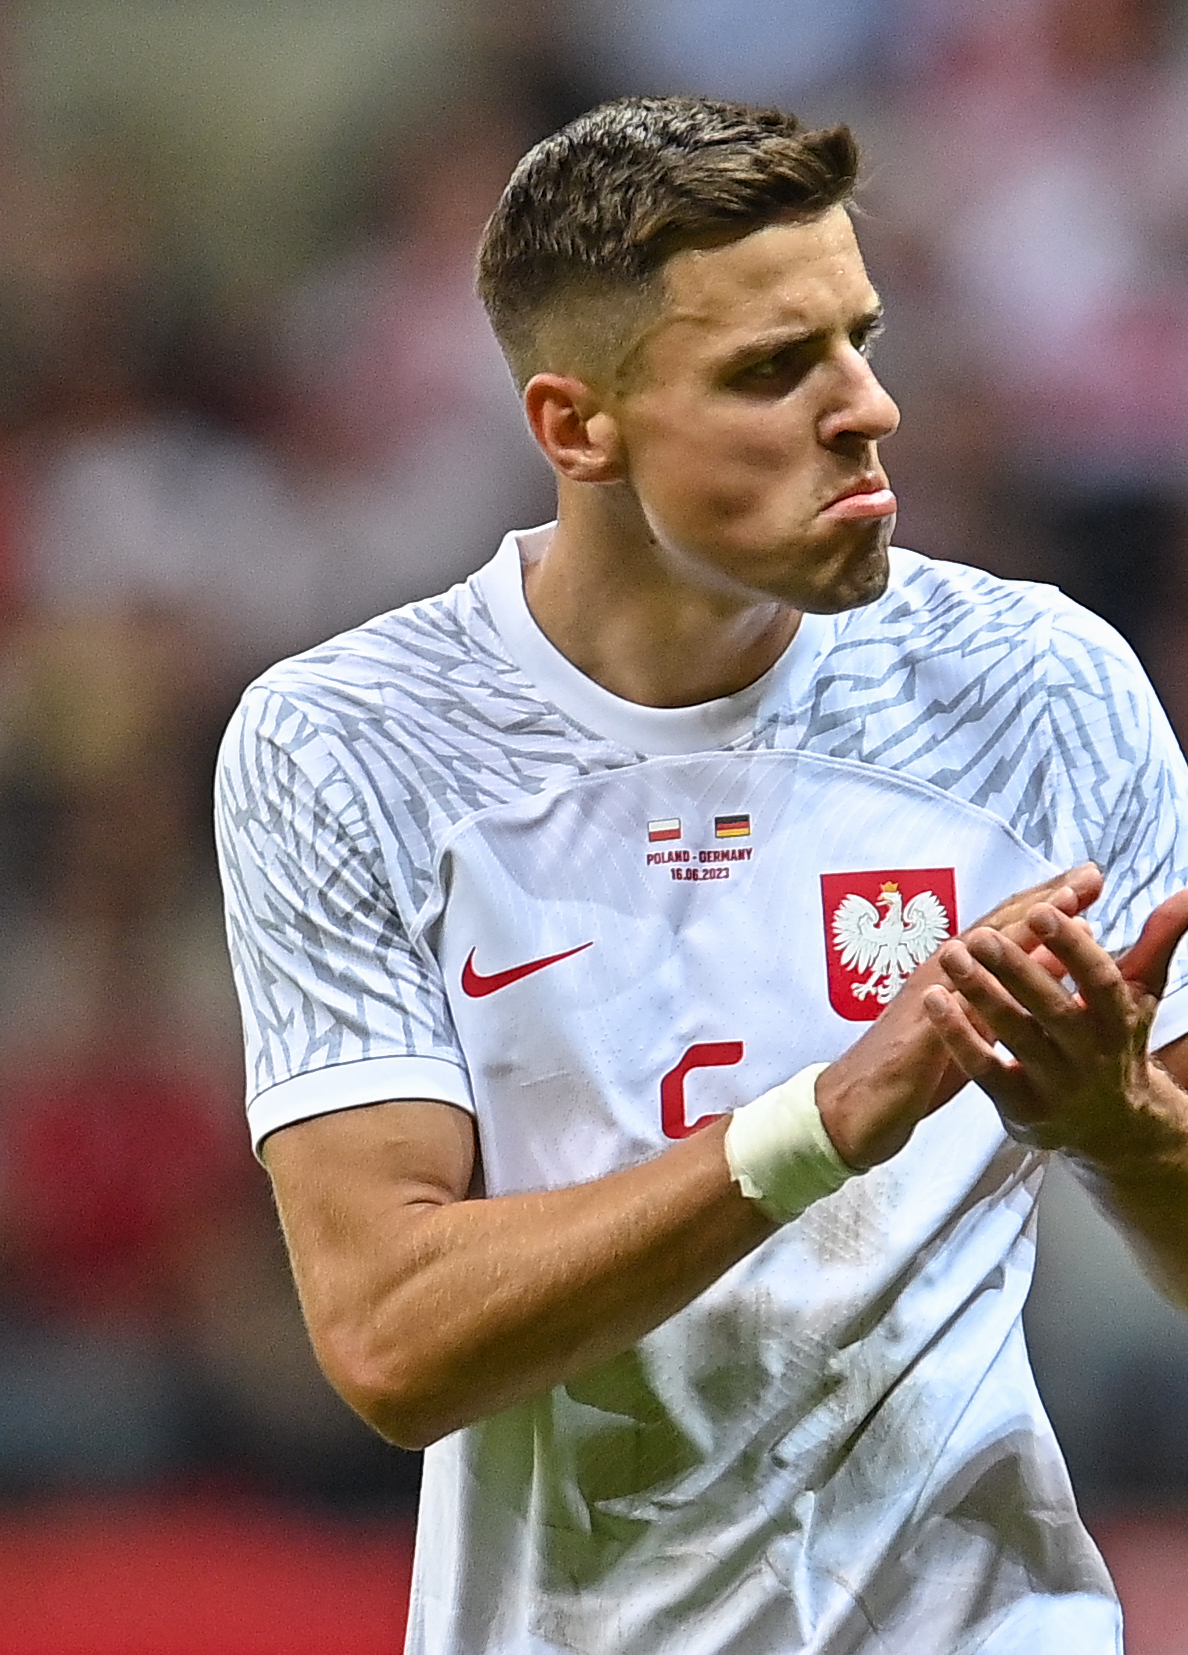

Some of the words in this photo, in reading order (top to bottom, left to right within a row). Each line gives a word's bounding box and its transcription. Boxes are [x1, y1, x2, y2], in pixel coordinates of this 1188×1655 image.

[646, 849, 690, 865] POLAND
[699, 848, 753, 863] GERMANY
[670, 867, 730, 881] 16.06.2023
